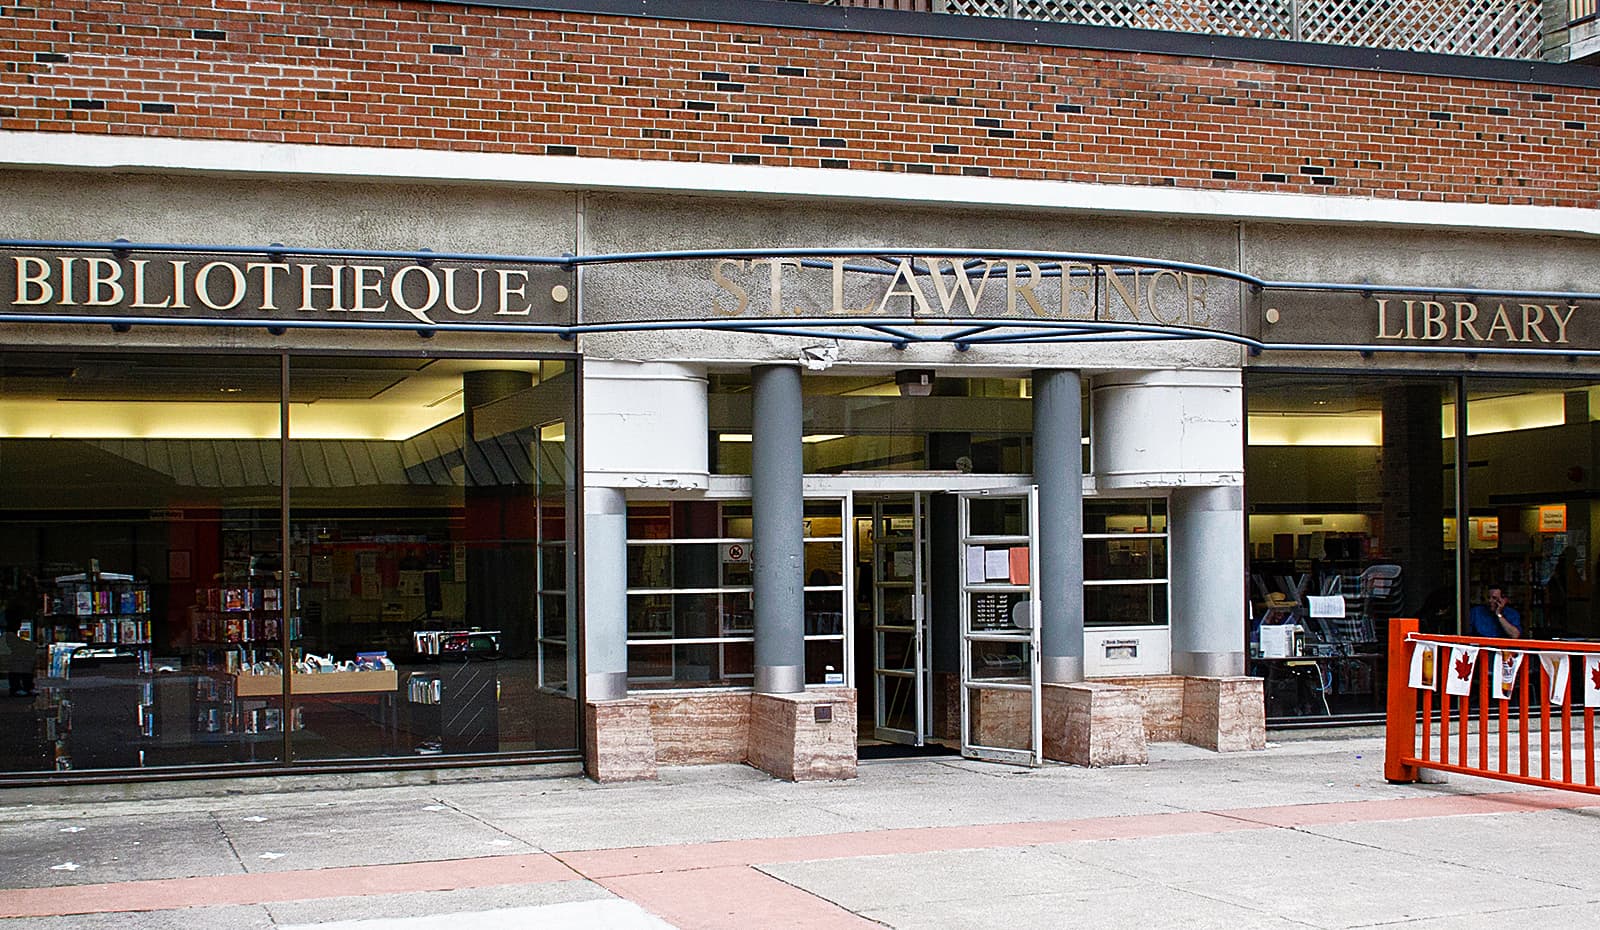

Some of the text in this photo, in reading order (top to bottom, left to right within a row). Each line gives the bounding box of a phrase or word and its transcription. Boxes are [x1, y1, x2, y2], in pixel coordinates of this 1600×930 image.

[10, 255, 532, 325] BIBLIOTHEQUE
[712, 256, 1212, 327] ST. LAWRENCE
[1375, 299, 1578, 343] LIBRARY
